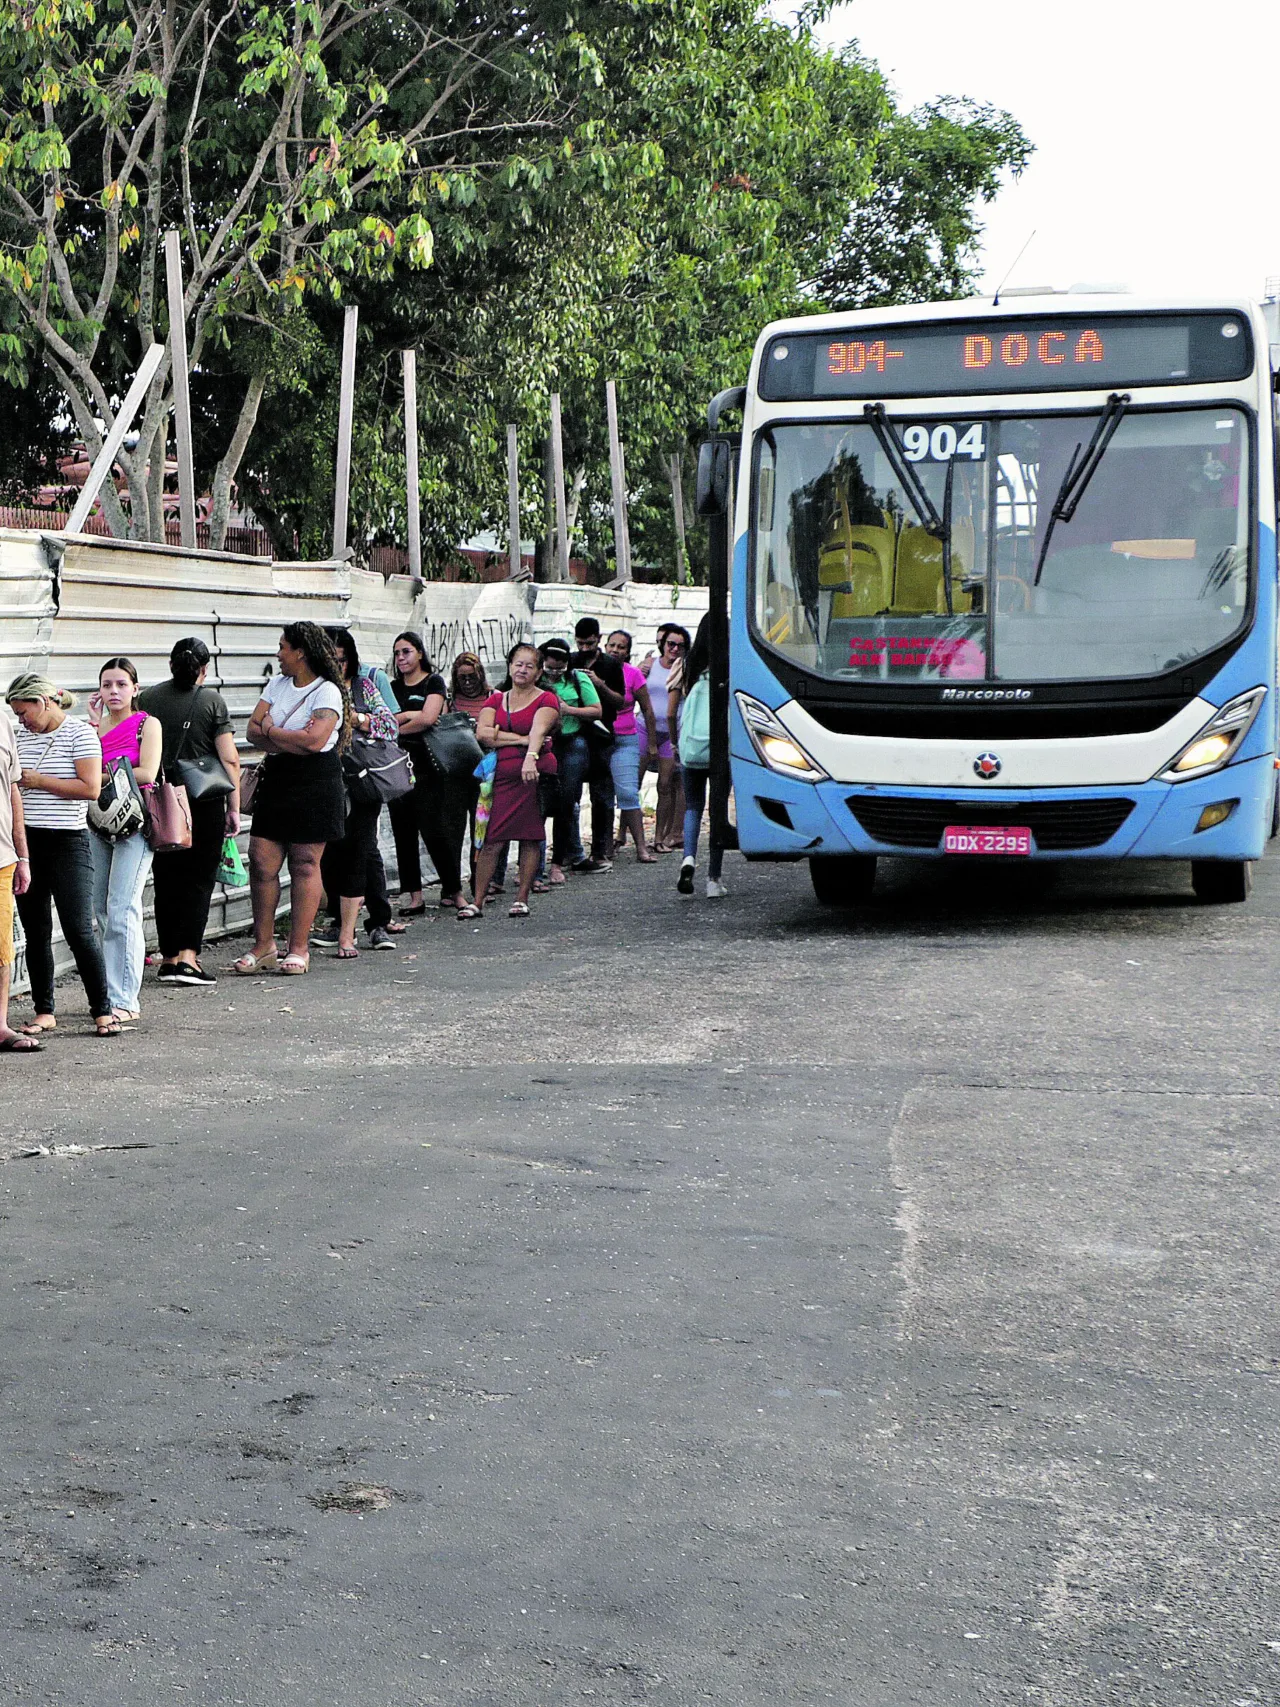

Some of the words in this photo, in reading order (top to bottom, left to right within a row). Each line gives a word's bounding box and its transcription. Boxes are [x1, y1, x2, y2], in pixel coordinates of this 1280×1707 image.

[964, 329, 1105, 369] DOCA
[903, 423, 985, 462] 904
[942, 688, 1032, 700] Marcopolo
